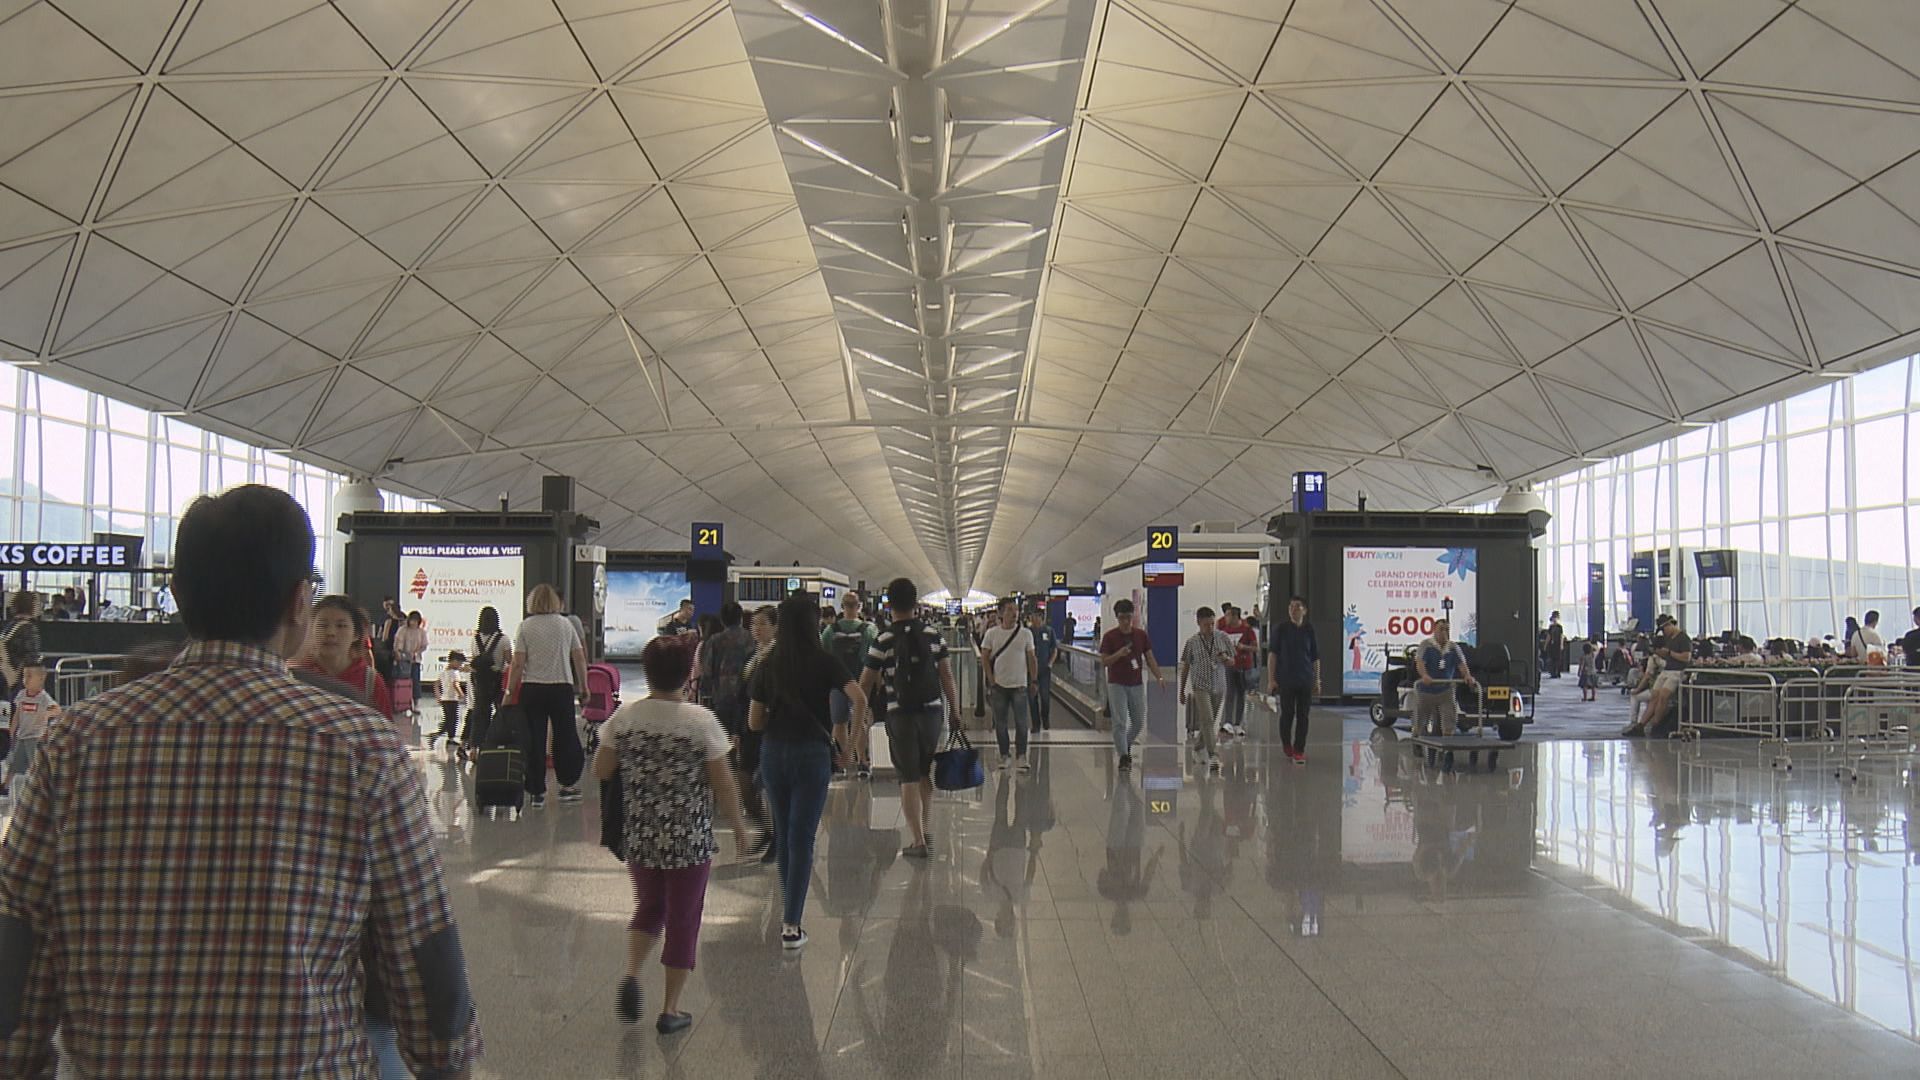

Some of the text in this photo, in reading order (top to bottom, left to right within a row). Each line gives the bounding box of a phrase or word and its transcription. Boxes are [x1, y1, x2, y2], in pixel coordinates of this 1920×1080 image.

[699, 529, 717, 545] 21
[1151, 532, 1172, 549] 20
[402, 546, 522, 555] BUYERS: PLEASE COME & VISIT
[32, 545, 125, 566] COFFEE
[1053, 574, 1065, 584] 22
[1375, 571, 1445, 579] GRAND OPENING
[469, 579, 515, 587] CHRISTMAS
[1367, 580, 1452, 588] CELEBRATION OFFER
[1388, 616, 1435, 636] 600
[433, 628, 456, 637] TOYS
[457, 628, 464, 637] &
